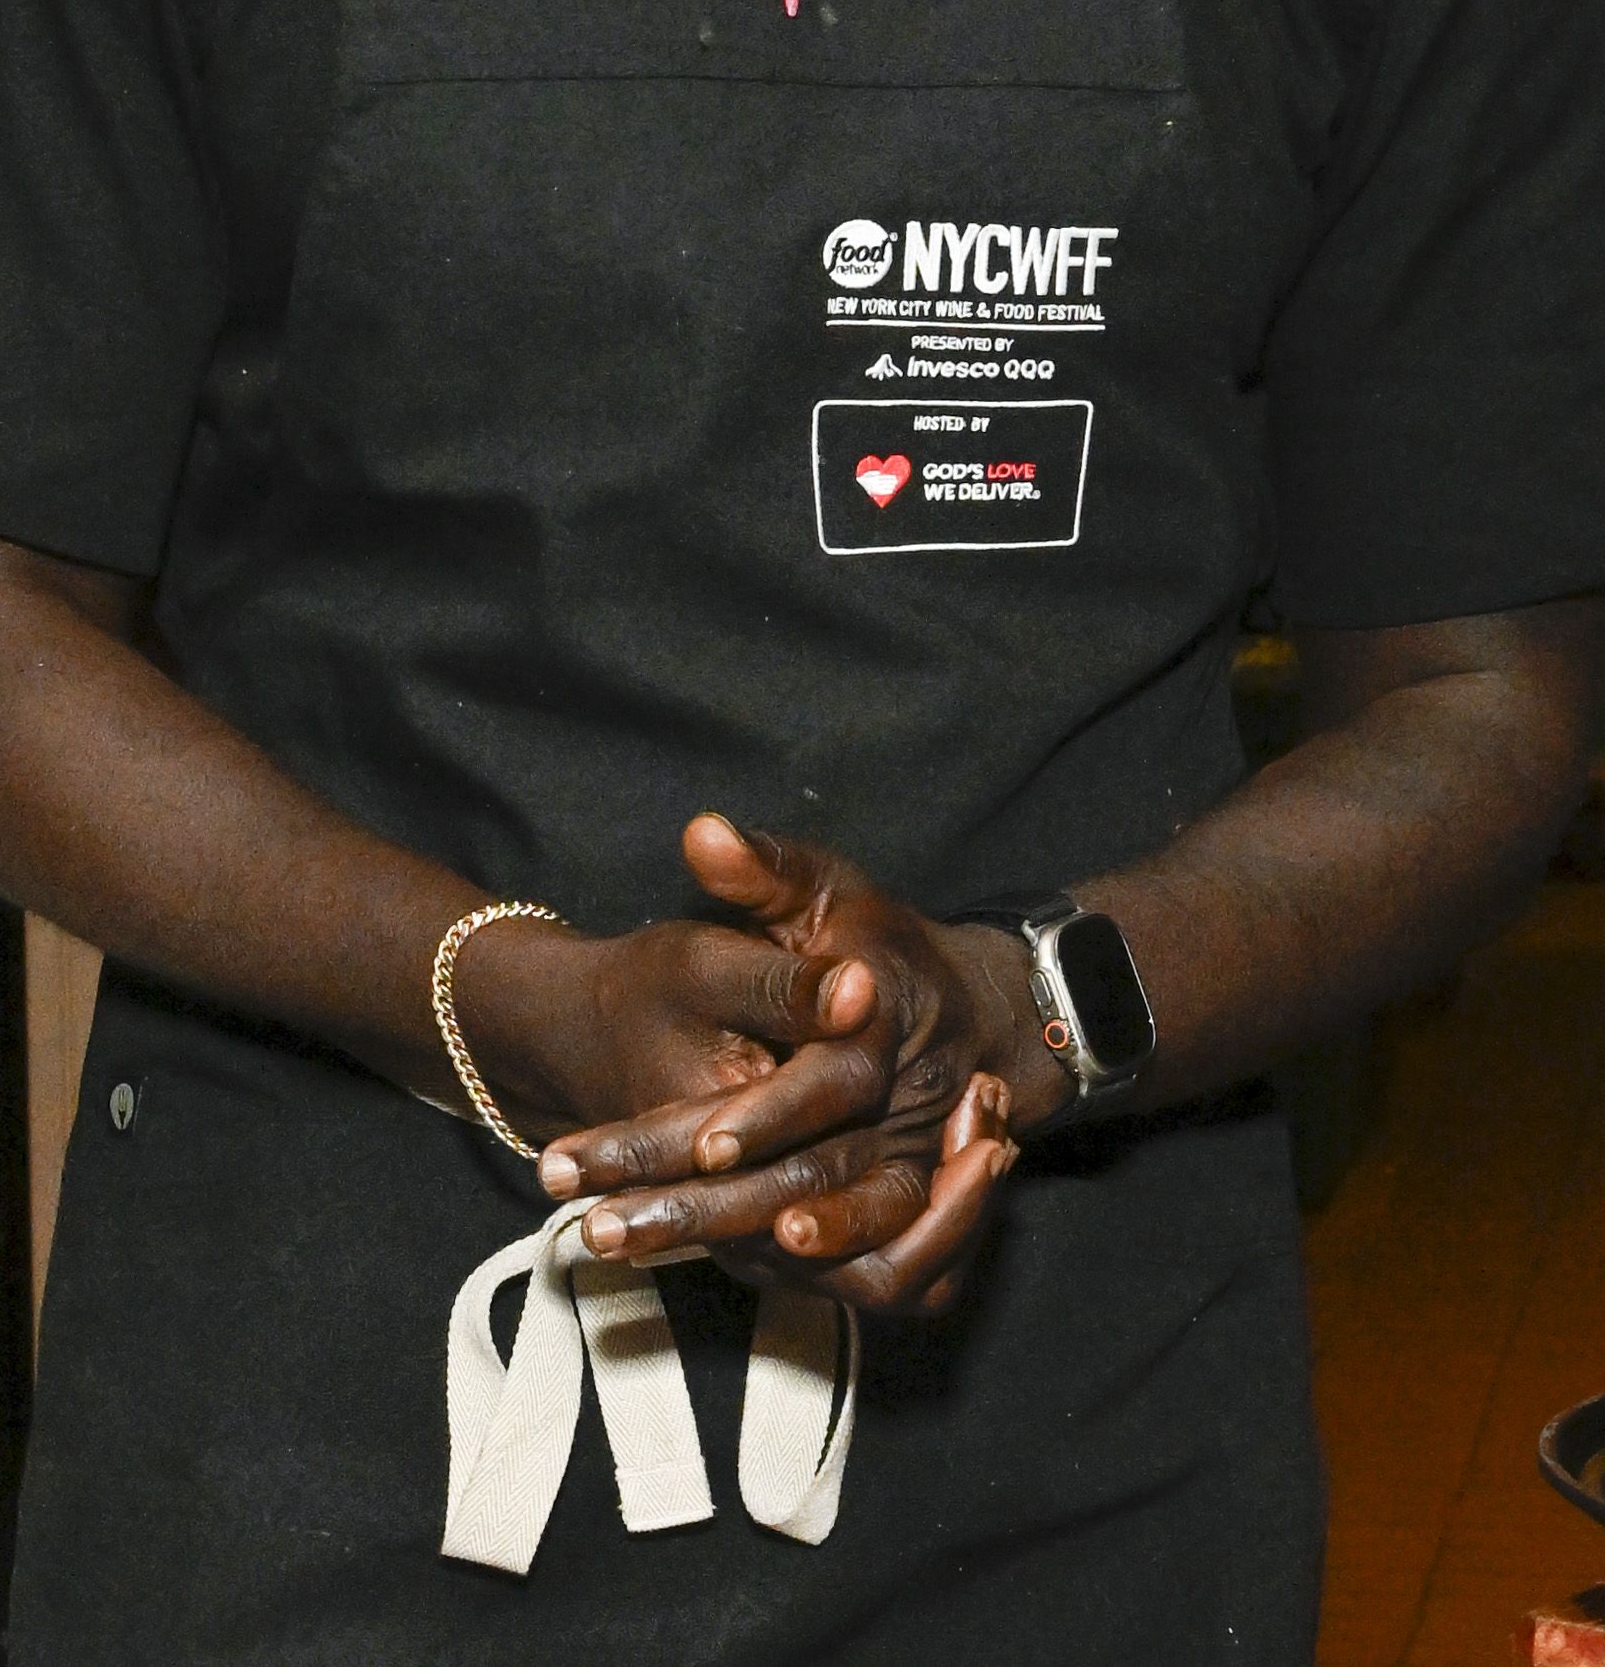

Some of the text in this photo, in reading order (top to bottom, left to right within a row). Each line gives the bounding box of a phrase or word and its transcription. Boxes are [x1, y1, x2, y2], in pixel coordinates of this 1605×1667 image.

[827, 237, 890, 272] food
[903, 220, 1119, 296] NYCWFF
[827, 296, 1106, 322] NEW YORK CITY WINE & FOOD FESTIVAL
[911, 335, 1015, 353] PRESENTED BY
[1003, 359, 1056, 380] QQQ
[913, 415, 991, 433] HOSTED BY
[922, 462, 1037, 481] GOD'S LOVE
[923, 482, 956, 502] WE
